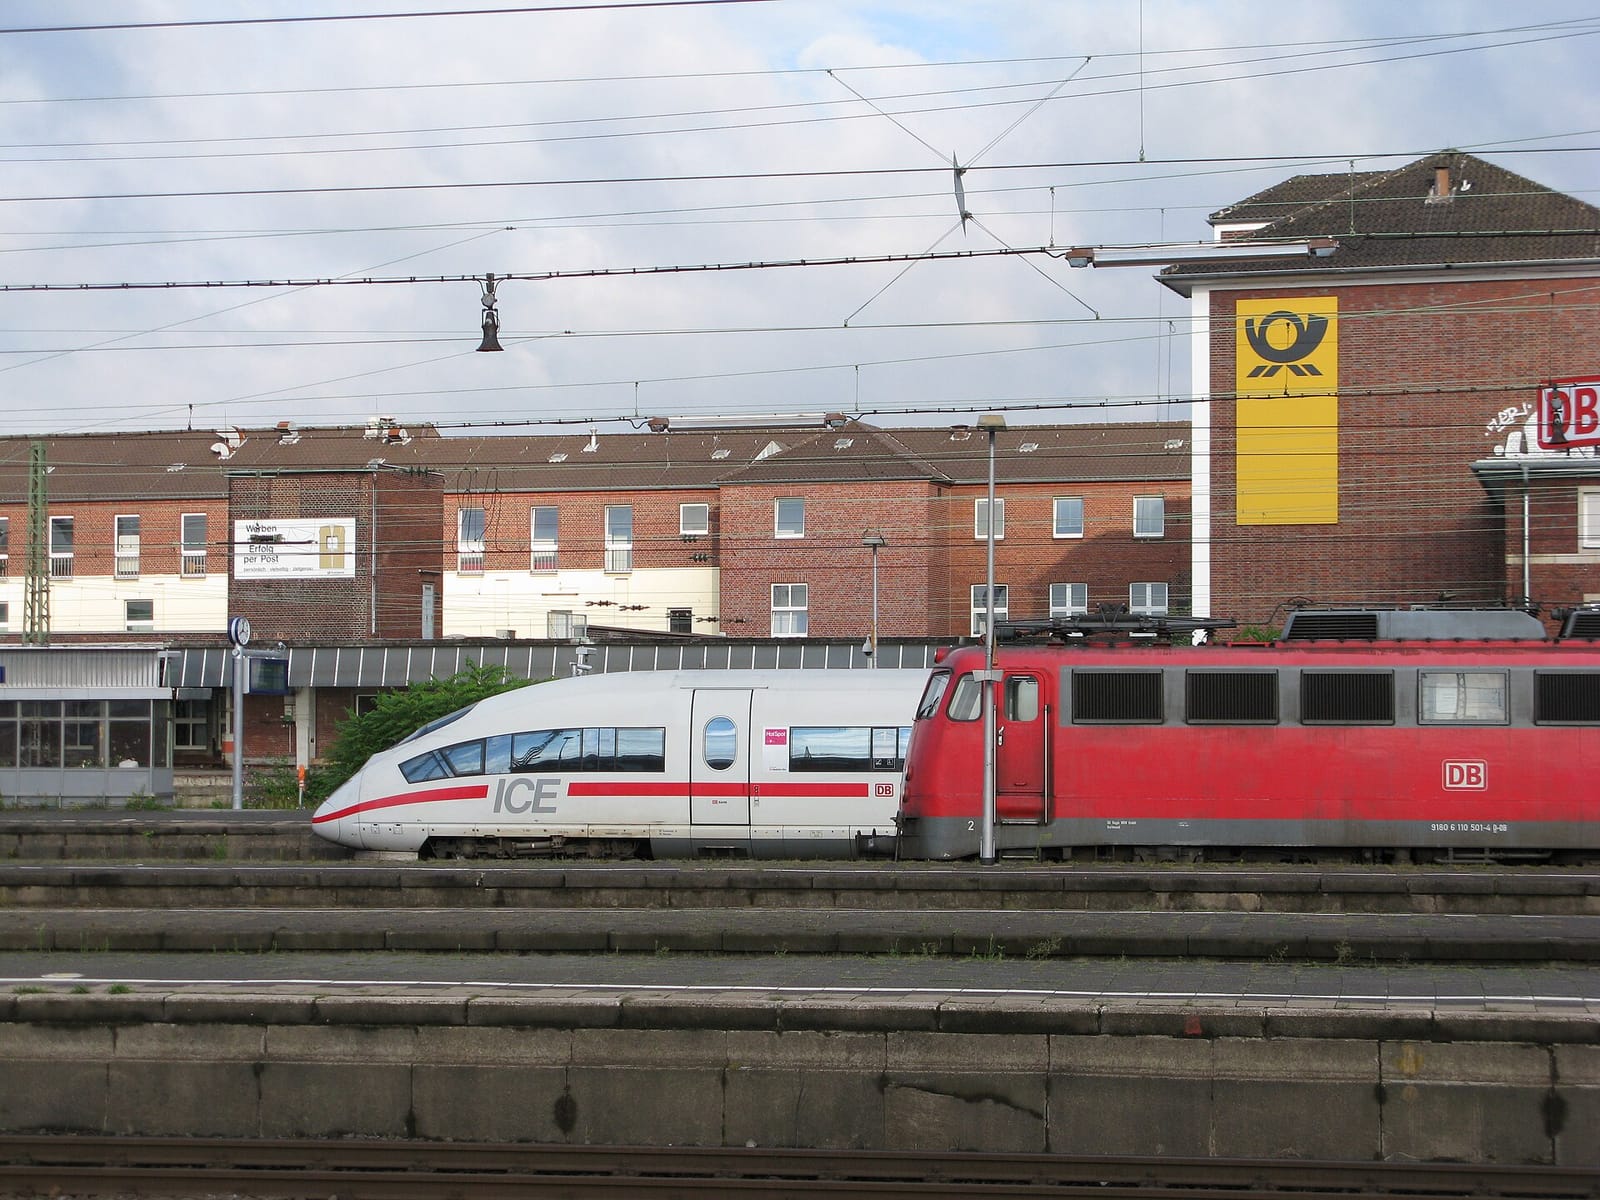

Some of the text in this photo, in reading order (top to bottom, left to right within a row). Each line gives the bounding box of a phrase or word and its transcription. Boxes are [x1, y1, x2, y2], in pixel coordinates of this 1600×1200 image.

[1546, 386, 1599, 438] DB
[244, 555, 279, 564] per Post
[1448, 764, 1482, 786] DB
[877, 785, 892, 795] DB
[493, 778, 561, 814] ICE
[967, 820, 975, 831] 2
[1431, 823, 1449, 832] 9180
[1450, 823, 1456, 832] 6
[1457, 823, 1469, 832] 110
[1470, 823, 1491, 832] 501-4
